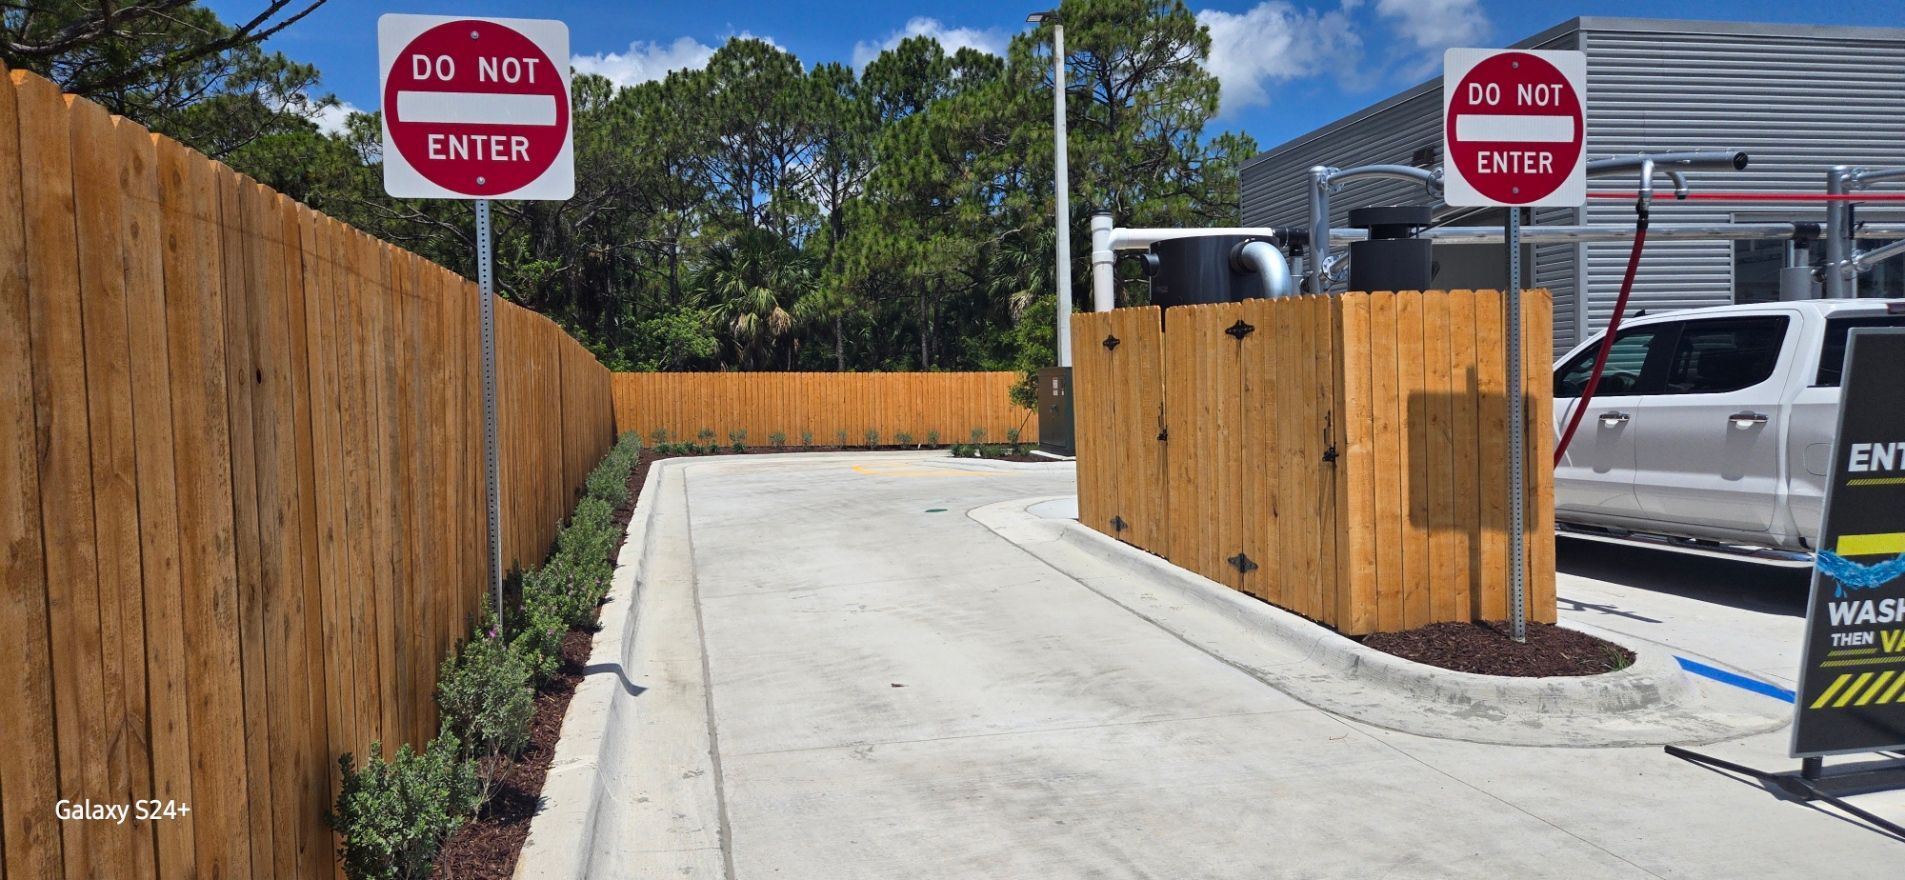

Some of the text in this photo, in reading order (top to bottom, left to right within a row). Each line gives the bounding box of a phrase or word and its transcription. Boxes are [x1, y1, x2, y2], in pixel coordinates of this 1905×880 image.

[412, 54, 540, 84] DO NOT
[1468, 82, 1564, 107] DO NOT
[428, 133, 531, 162] ENTER
[1477, 150, 1553, 174] ENTER
[1830, 630, 1875, 647] THEN
